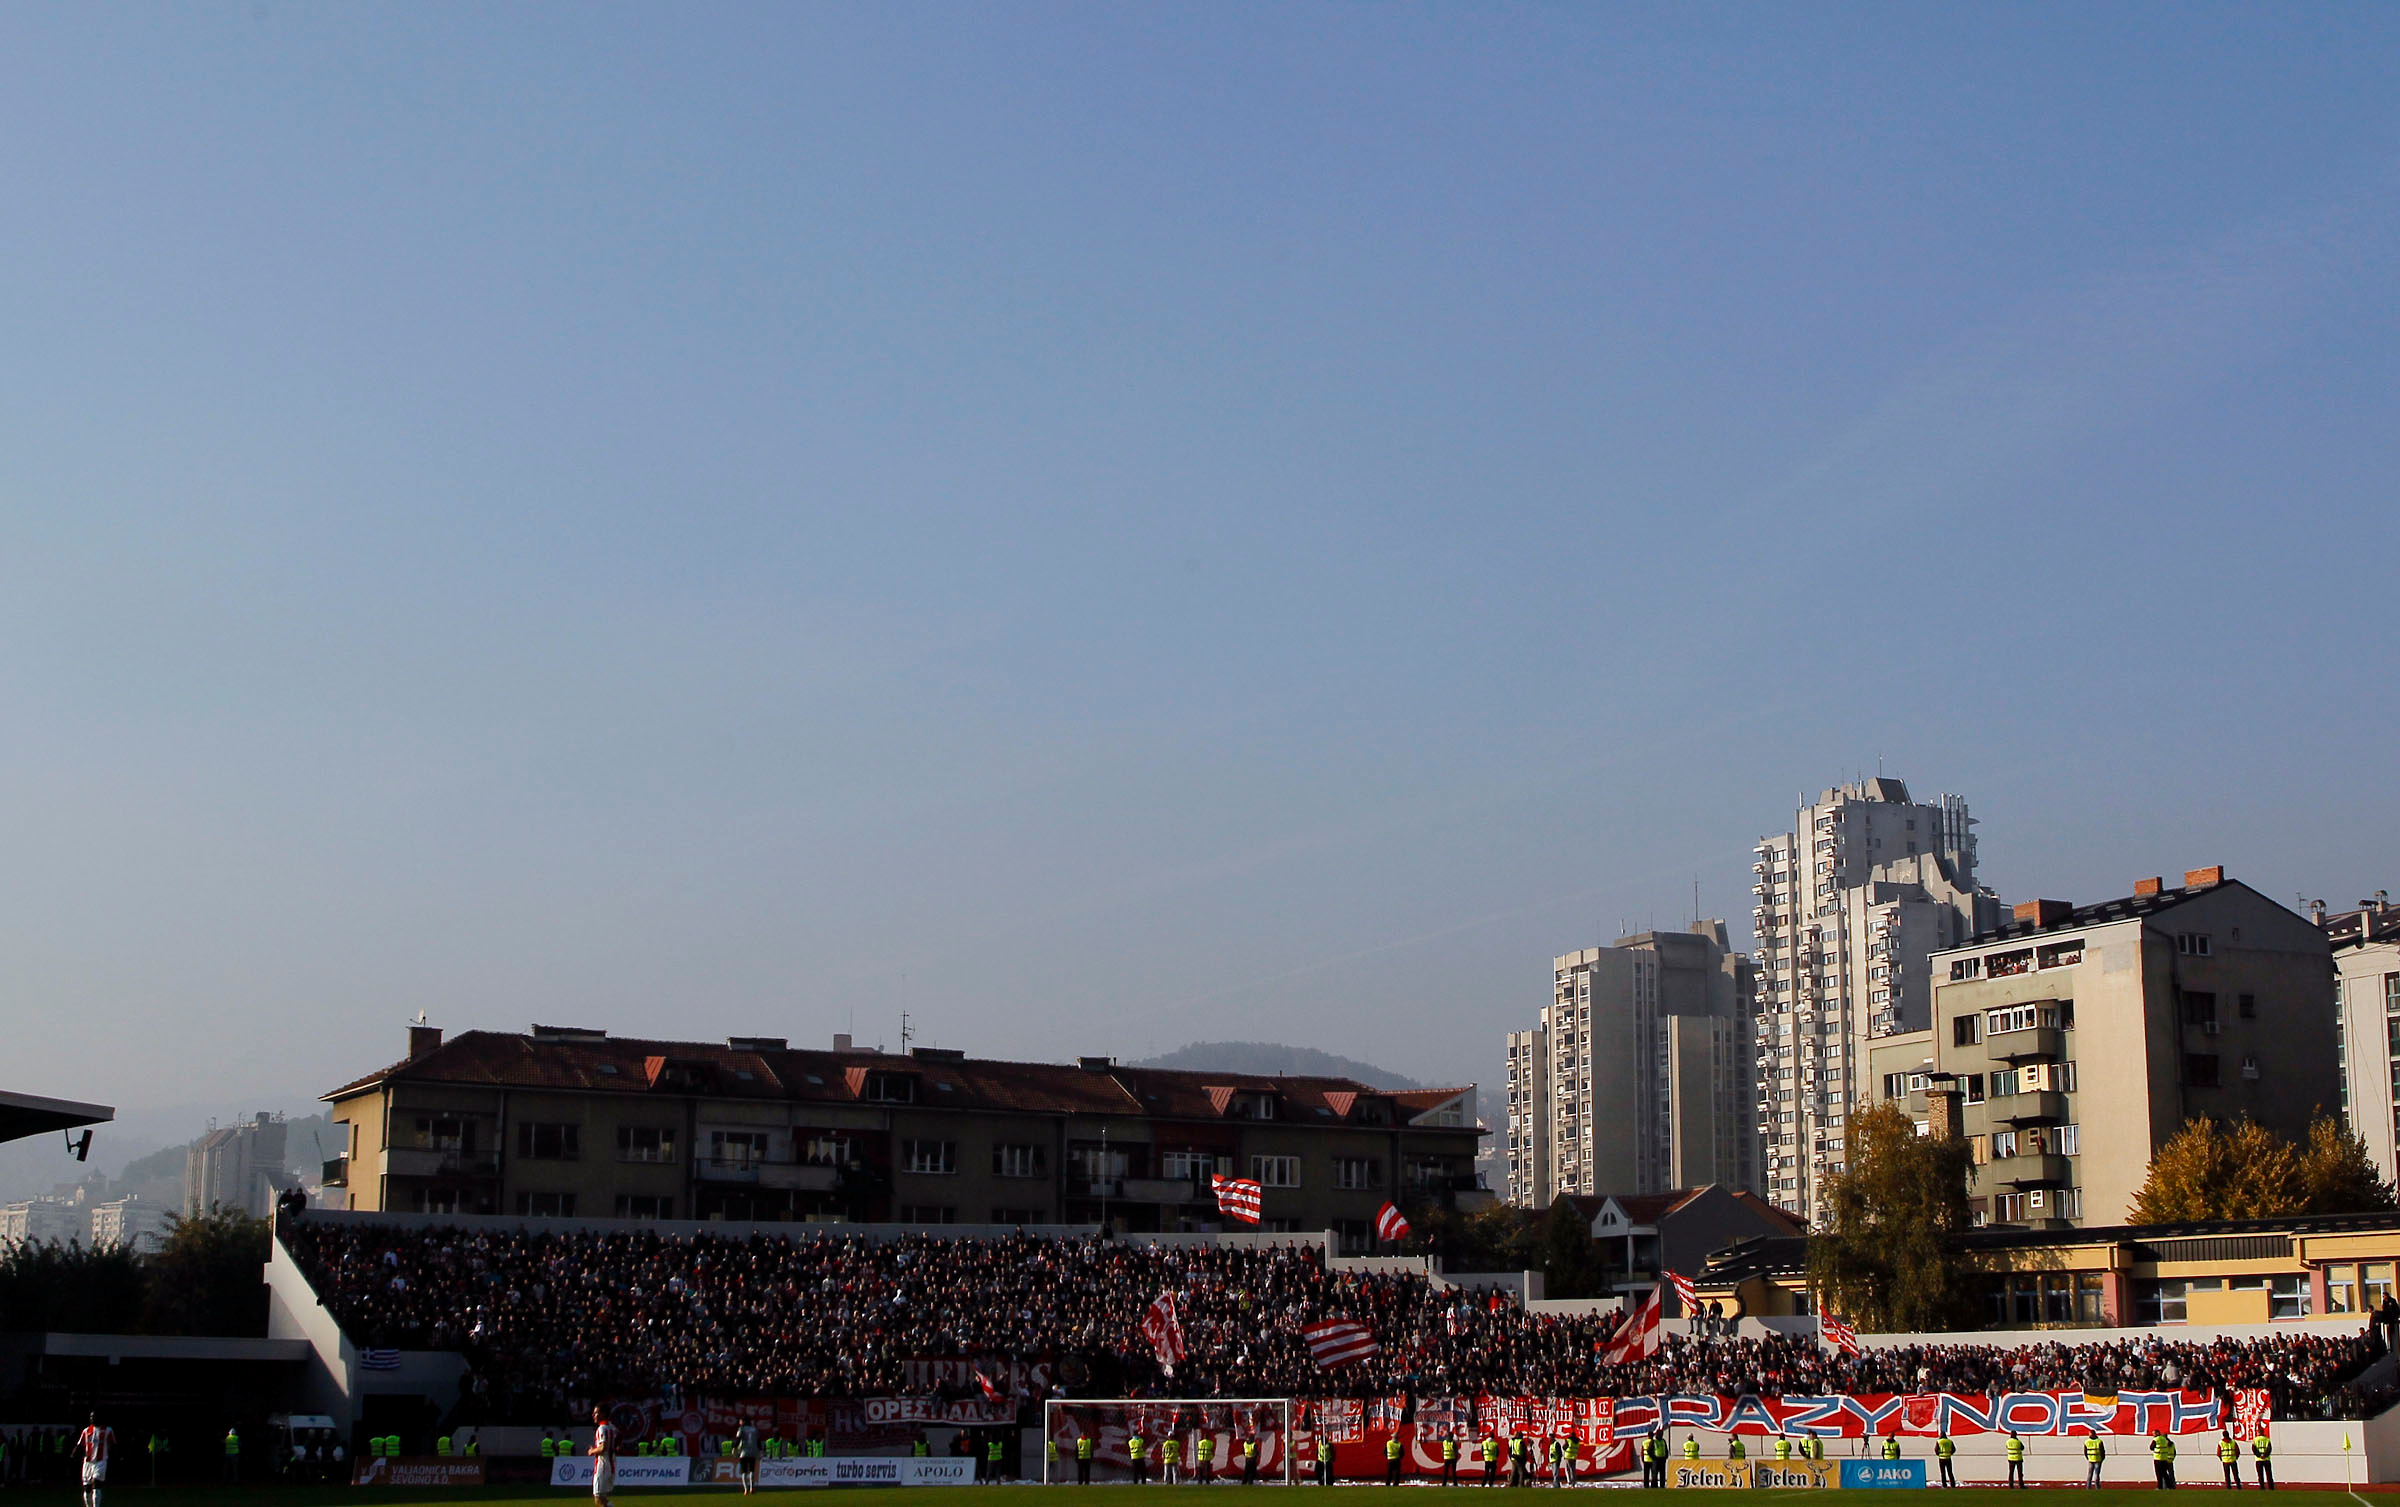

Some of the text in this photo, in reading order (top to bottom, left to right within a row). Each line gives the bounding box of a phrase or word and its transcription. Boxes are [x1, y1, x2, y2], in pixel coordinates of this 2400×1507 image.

[1612, 1388, 2222, 1440] CRAZY NORTH
[449, 1465, 480, 1476] BAKRA
[836, 1460, 897, 1478] turbo servis
[913, 1466, 963, 1477] APOLO
[1676, 1466, 1725, 1488] Jelen
[1758, 1466, 1808, 1488] Jelen
[1877, 1468, 1912, 1480] JAKO
